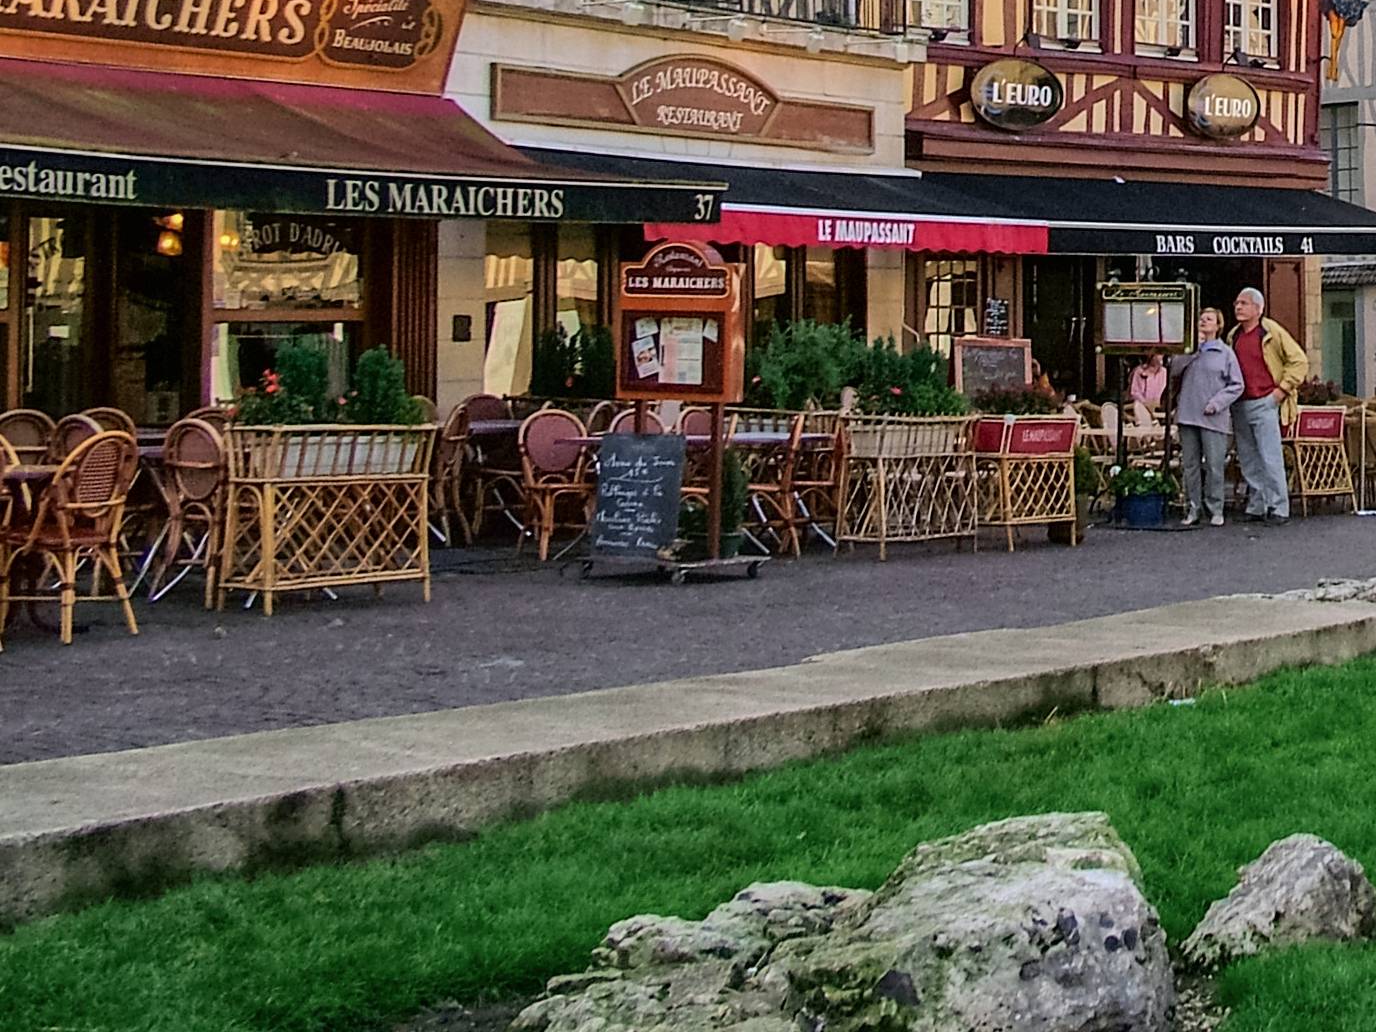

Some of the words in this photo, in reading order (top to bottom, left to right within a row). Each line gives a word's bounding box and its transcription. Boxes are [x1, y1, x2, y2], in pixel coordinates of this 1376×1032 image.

[632, 75, 653, 105] LE
[655, 67, 770, 115] MAUPASSANT
[992, 78, 1052, 107] L'EURO
[656, 105, 743, 131] RESTAURANT
[1204, 93, 1252, 118] L'EURO
[325, 178, 380, 212] LES
[388, 182, 564, 219] MARAICHERS
[694, 194, 714, 221] 37
[818, 219, 832, 242] LE
[834, 219, 916, 245] MAUPASSANT
[1155, 235, 1195, 253] BARS
[1212, 236, 1284, 254] COCKTAILS
[1300, 236, 1314, 254] 41
[628, 276, 650, 289] LES
[653, 276, 725, 289] MARAICHERS
